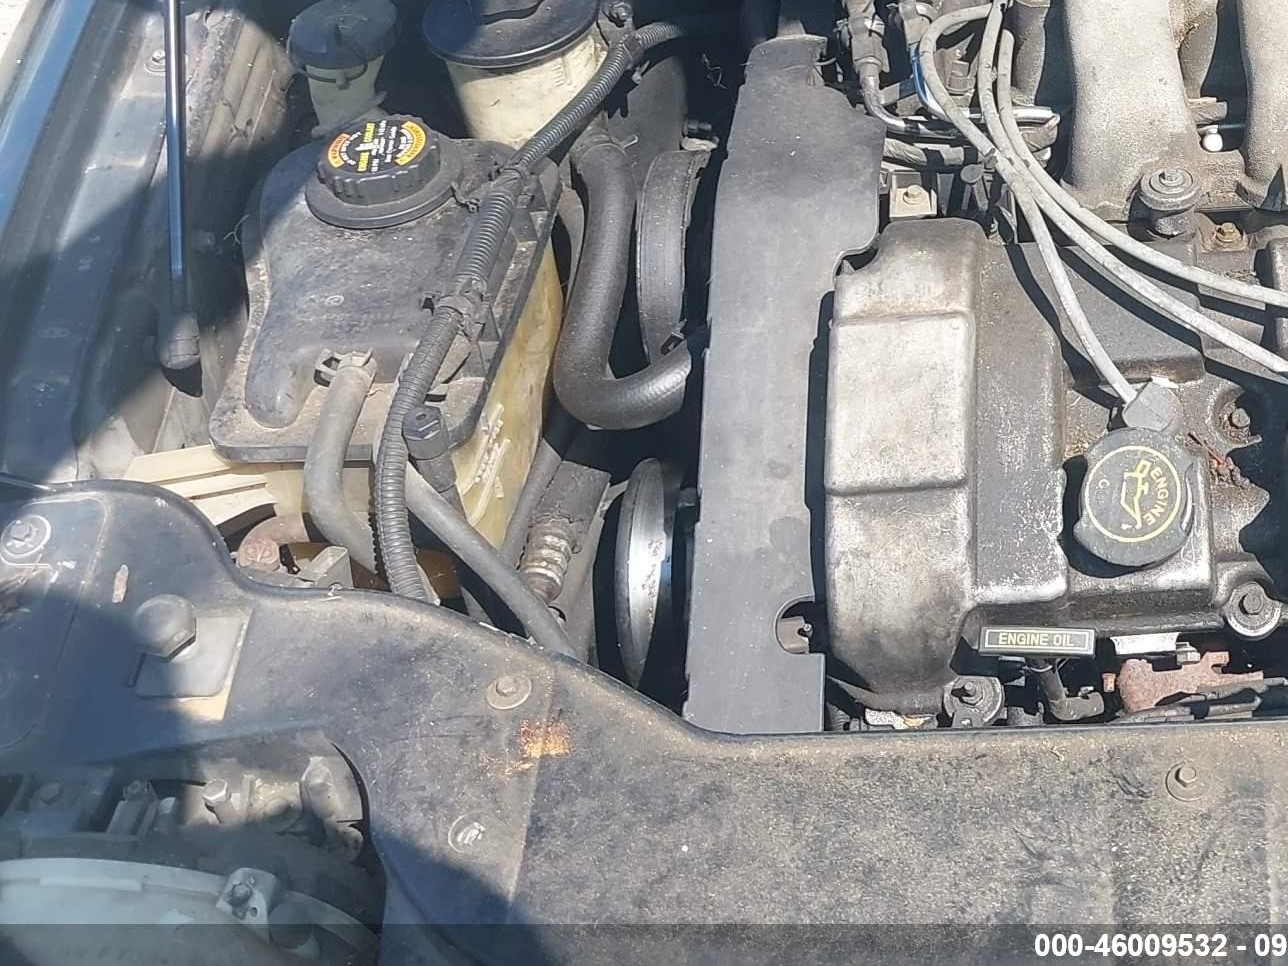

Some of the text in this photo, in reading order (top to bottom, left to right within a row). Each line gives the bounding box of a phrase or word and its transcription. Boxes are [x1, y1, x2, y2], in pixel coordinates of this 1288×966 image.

[1142, 466, 1169, 526] ENGINE
[998, 632, 1075, 647] ENGINE OIL
